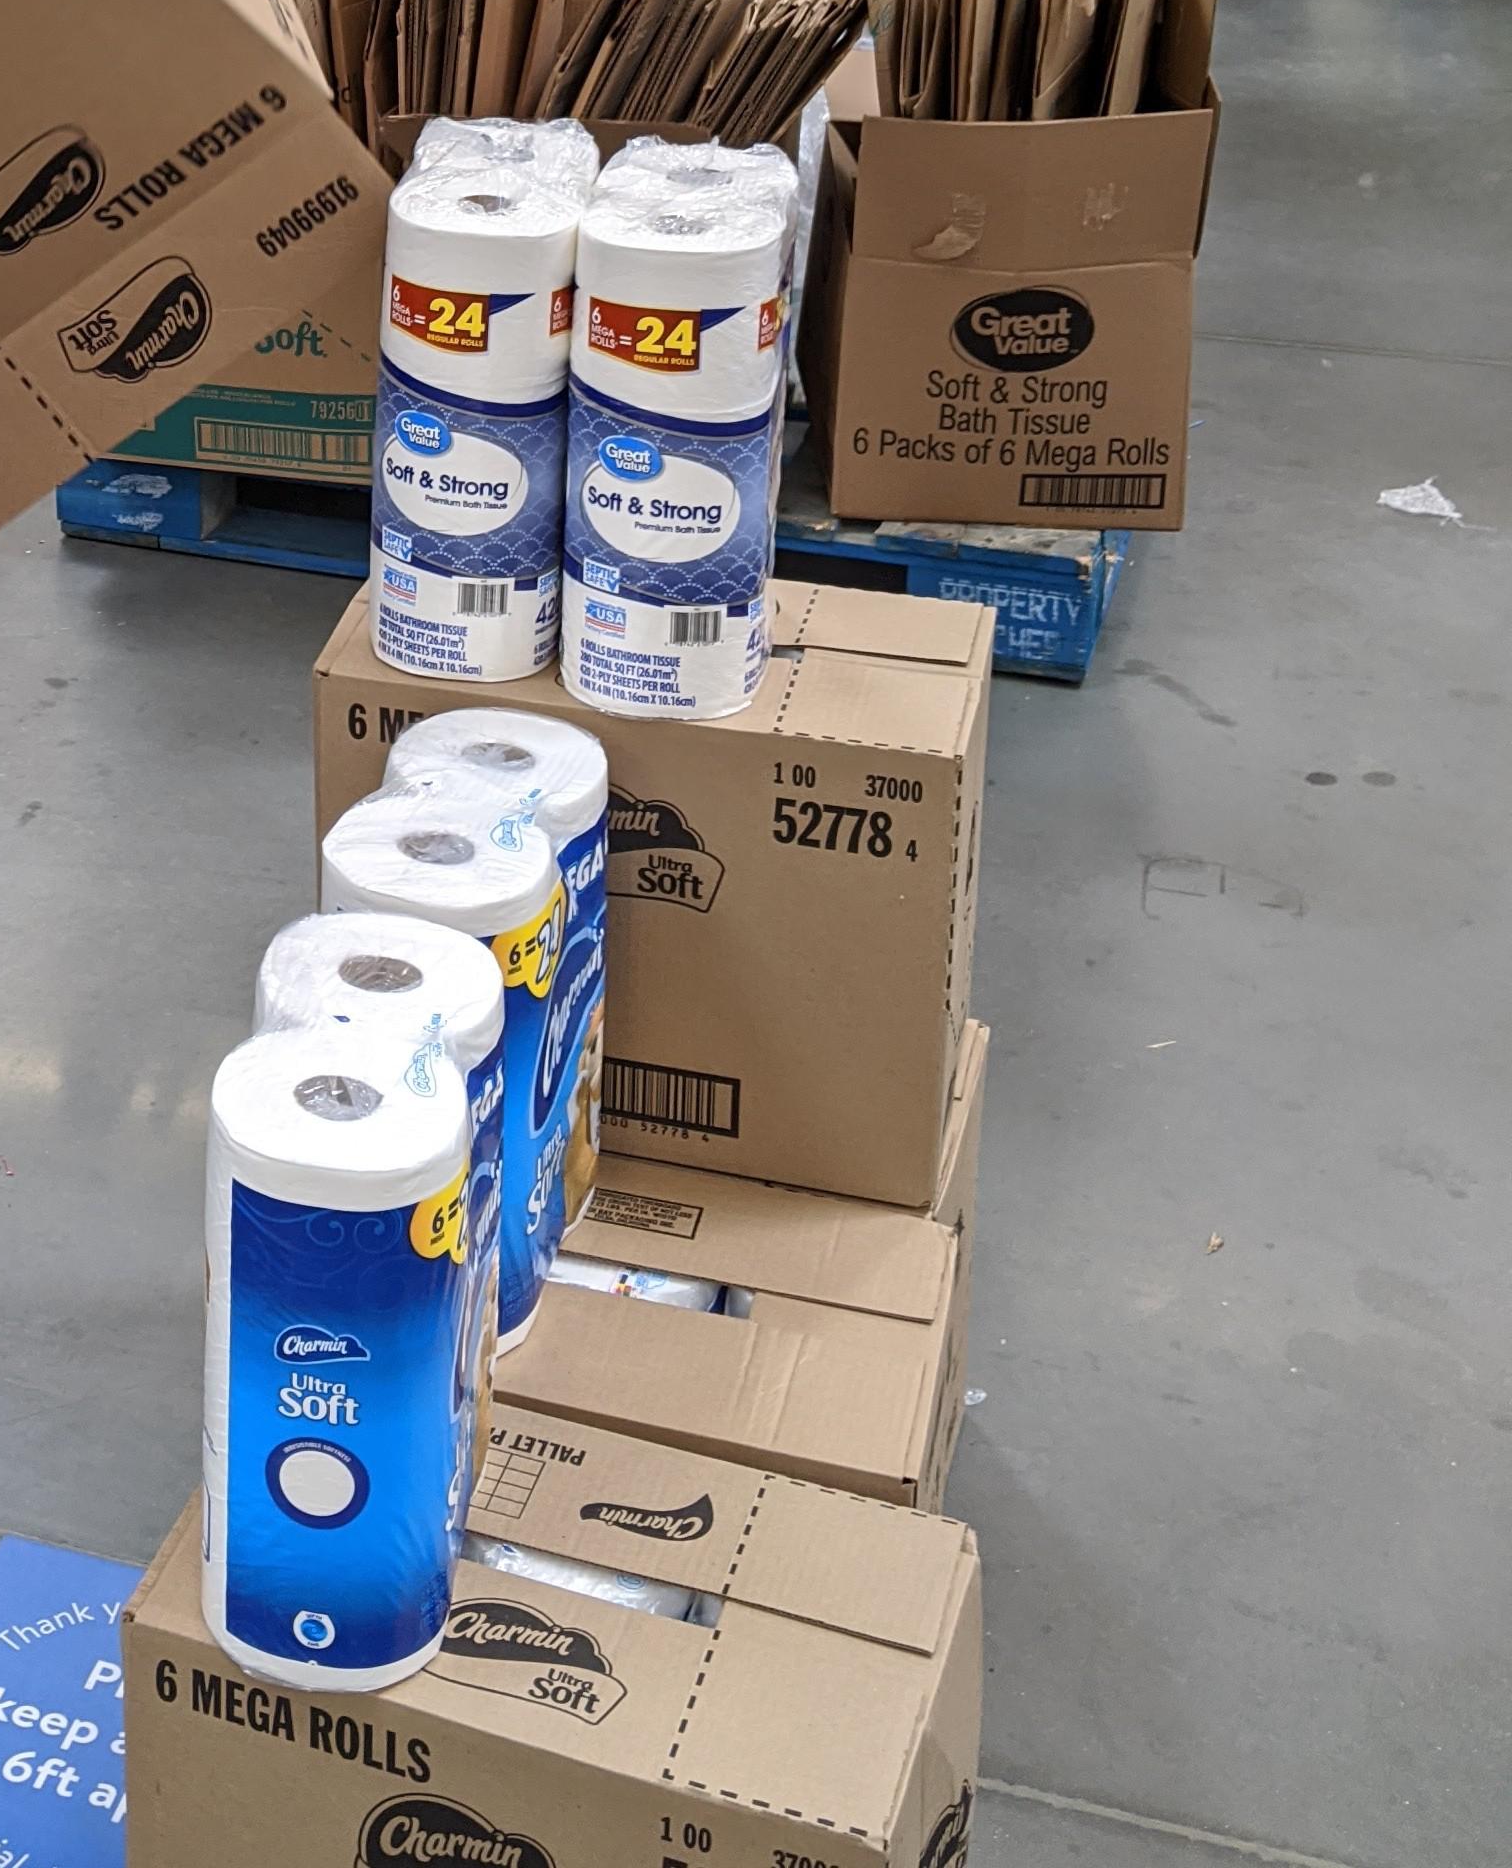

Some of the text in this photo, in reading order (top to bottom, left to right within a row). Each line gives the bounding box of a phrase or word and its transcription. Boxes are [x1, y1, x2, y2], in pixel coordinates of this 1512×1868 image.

[93, 84, 288, 232] 6 MEGA ROLLS
[2, 156, 92, 244] Charmin
[256, 174, 360, 259] 91999049
[392, 285, 486, 338] 6 24
[592, 306, 601, 323] 6
[970, 306, 1072, 337] Great
[67, 309, 119, 354] Soft
[87, 330, 121, 357] Ultra
[124, 290, 200, 374] Charmin
[592, 324, 615, 338] MEGA
[636, 316, 696, 356] 24
[993, 334, 1070, 356] Value
[634, 354, 694, 366] REGULAR ROLLS
[927, 370, 1107, 408] Soft & Strong
[401, 417, 440, 440] Great
[939, 403, 1090, 434] Bath Tissue
[409, 434, 440, 449] Value
[606, 443, 650, 464] Great
[853, 428, 1169, 472] 6 Packs of 6 Mega Rolls
[386, 458, 508, 500] Soft & Strong
[615, 459, 650, 473] Value
[425, 494, 507, 510] Premium Tissue
[588, 485, 722, 524] Soft & Strong
[635, 521, 720, 534] Premium Bath Tissue
[393, 577, 415, 592] USA
[585, 561, 617, 580] SEPTIC
[400, 611, 468, 636] BATHROOM TISSUE
[597, 610, 624, 626] USA
[404, 637, 467, 662] SHEETS ROLL
[593, 654, 613, 671] TOTAL
[607, 647, 680, 667] BATHROOM TISSUE
[612, 674, 680, 693] SHEETS PER ROLL
[348, 704, 367, 740] 6
[864, 774, 922, 803] 37000
[773, 797, 918, 862] 52778 4
[648, 854, 692, 874] Ultra
[638, 868, 703, 900] Soft
[509, 943, 521, 966] 6
[433, 1207, 444, 1234] 6
[283, 1335, 347, 1355] Charmin
[292, 1372, 346, 1395] Ultra
[278, 1387, 359, 1425] Soft
[510, 1428, 586, 1467] PALLET
[596, 1503, 704, 1541] Charmin
[447, 1611, 575, 1656] Charmin
[547, 1667, 593, 1693] Ultra
[528, 1676, 601, 1714] Soft
[155, 1658, 178, 1704] 6
[192, 1668, 295, 1742] MEGA
[310, 1705, 431, 1783] ROLLS
[1, 1750, 81, 1798] 6ft
[380, 1815, 523, 1868] Charmin
[683, 1823, 712, 1853] 00
